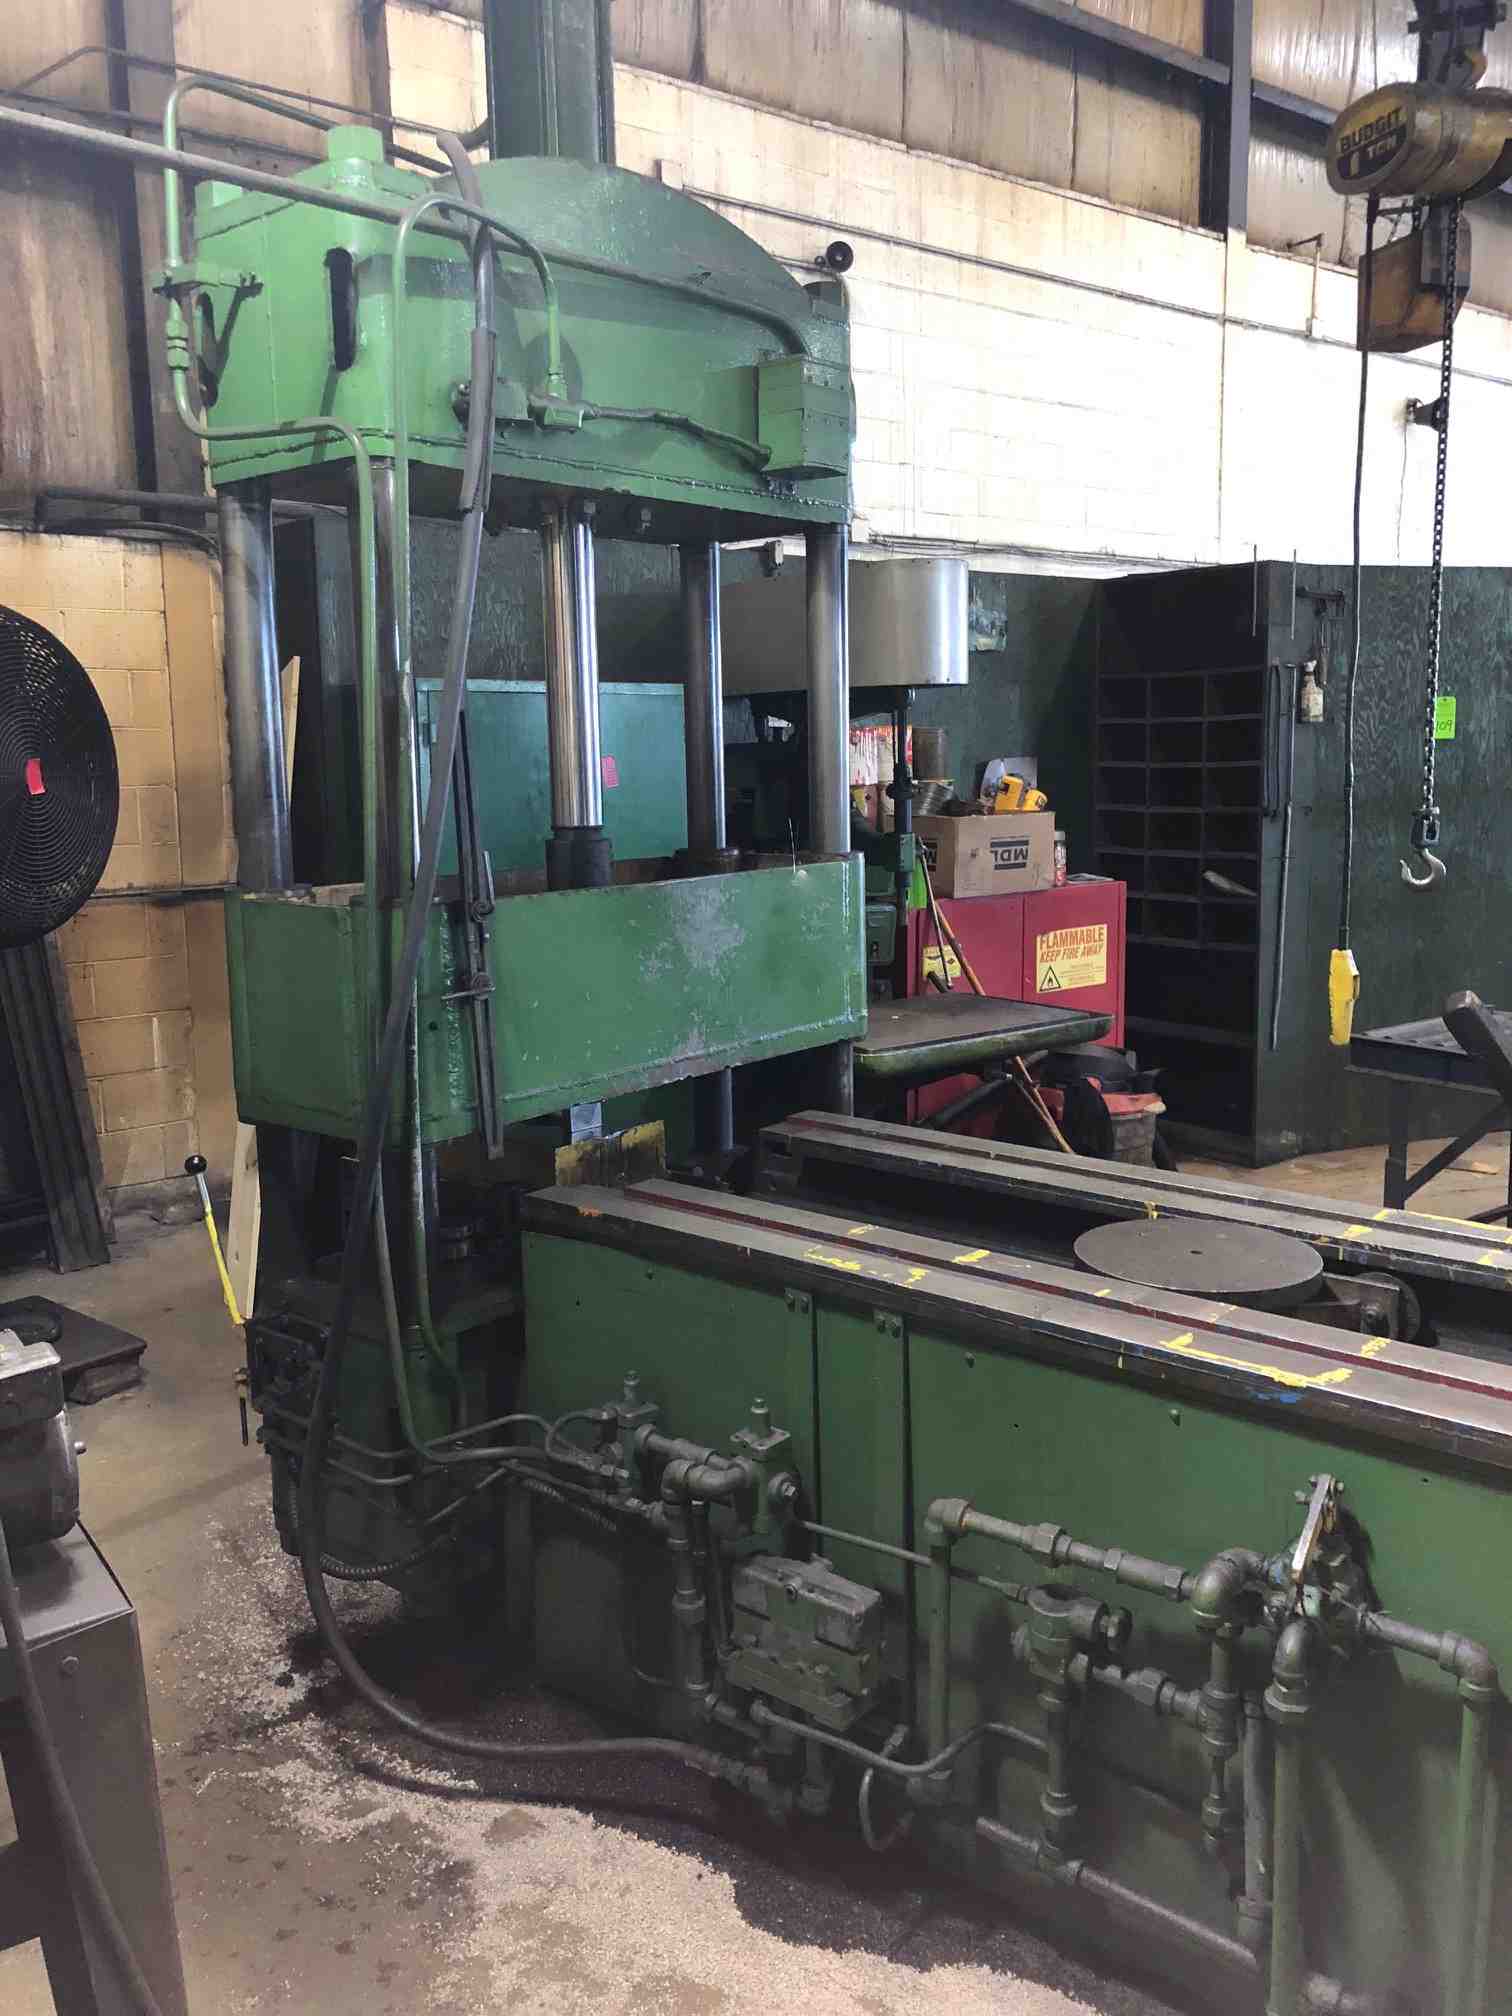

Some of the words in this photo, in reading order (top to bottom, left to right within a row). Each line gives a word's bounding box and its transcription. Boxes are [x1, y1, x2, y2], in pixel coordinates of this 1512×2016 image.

[1340, 106, 1403, 150] BUDGIT
[1039, 926, 1104, 950] FLAMMABLE
[1039, 948, 1060, 963] KEEP
[1061, 945, 1080, 960] FIRE
[1080, 943, 1104, 959] AWAY
